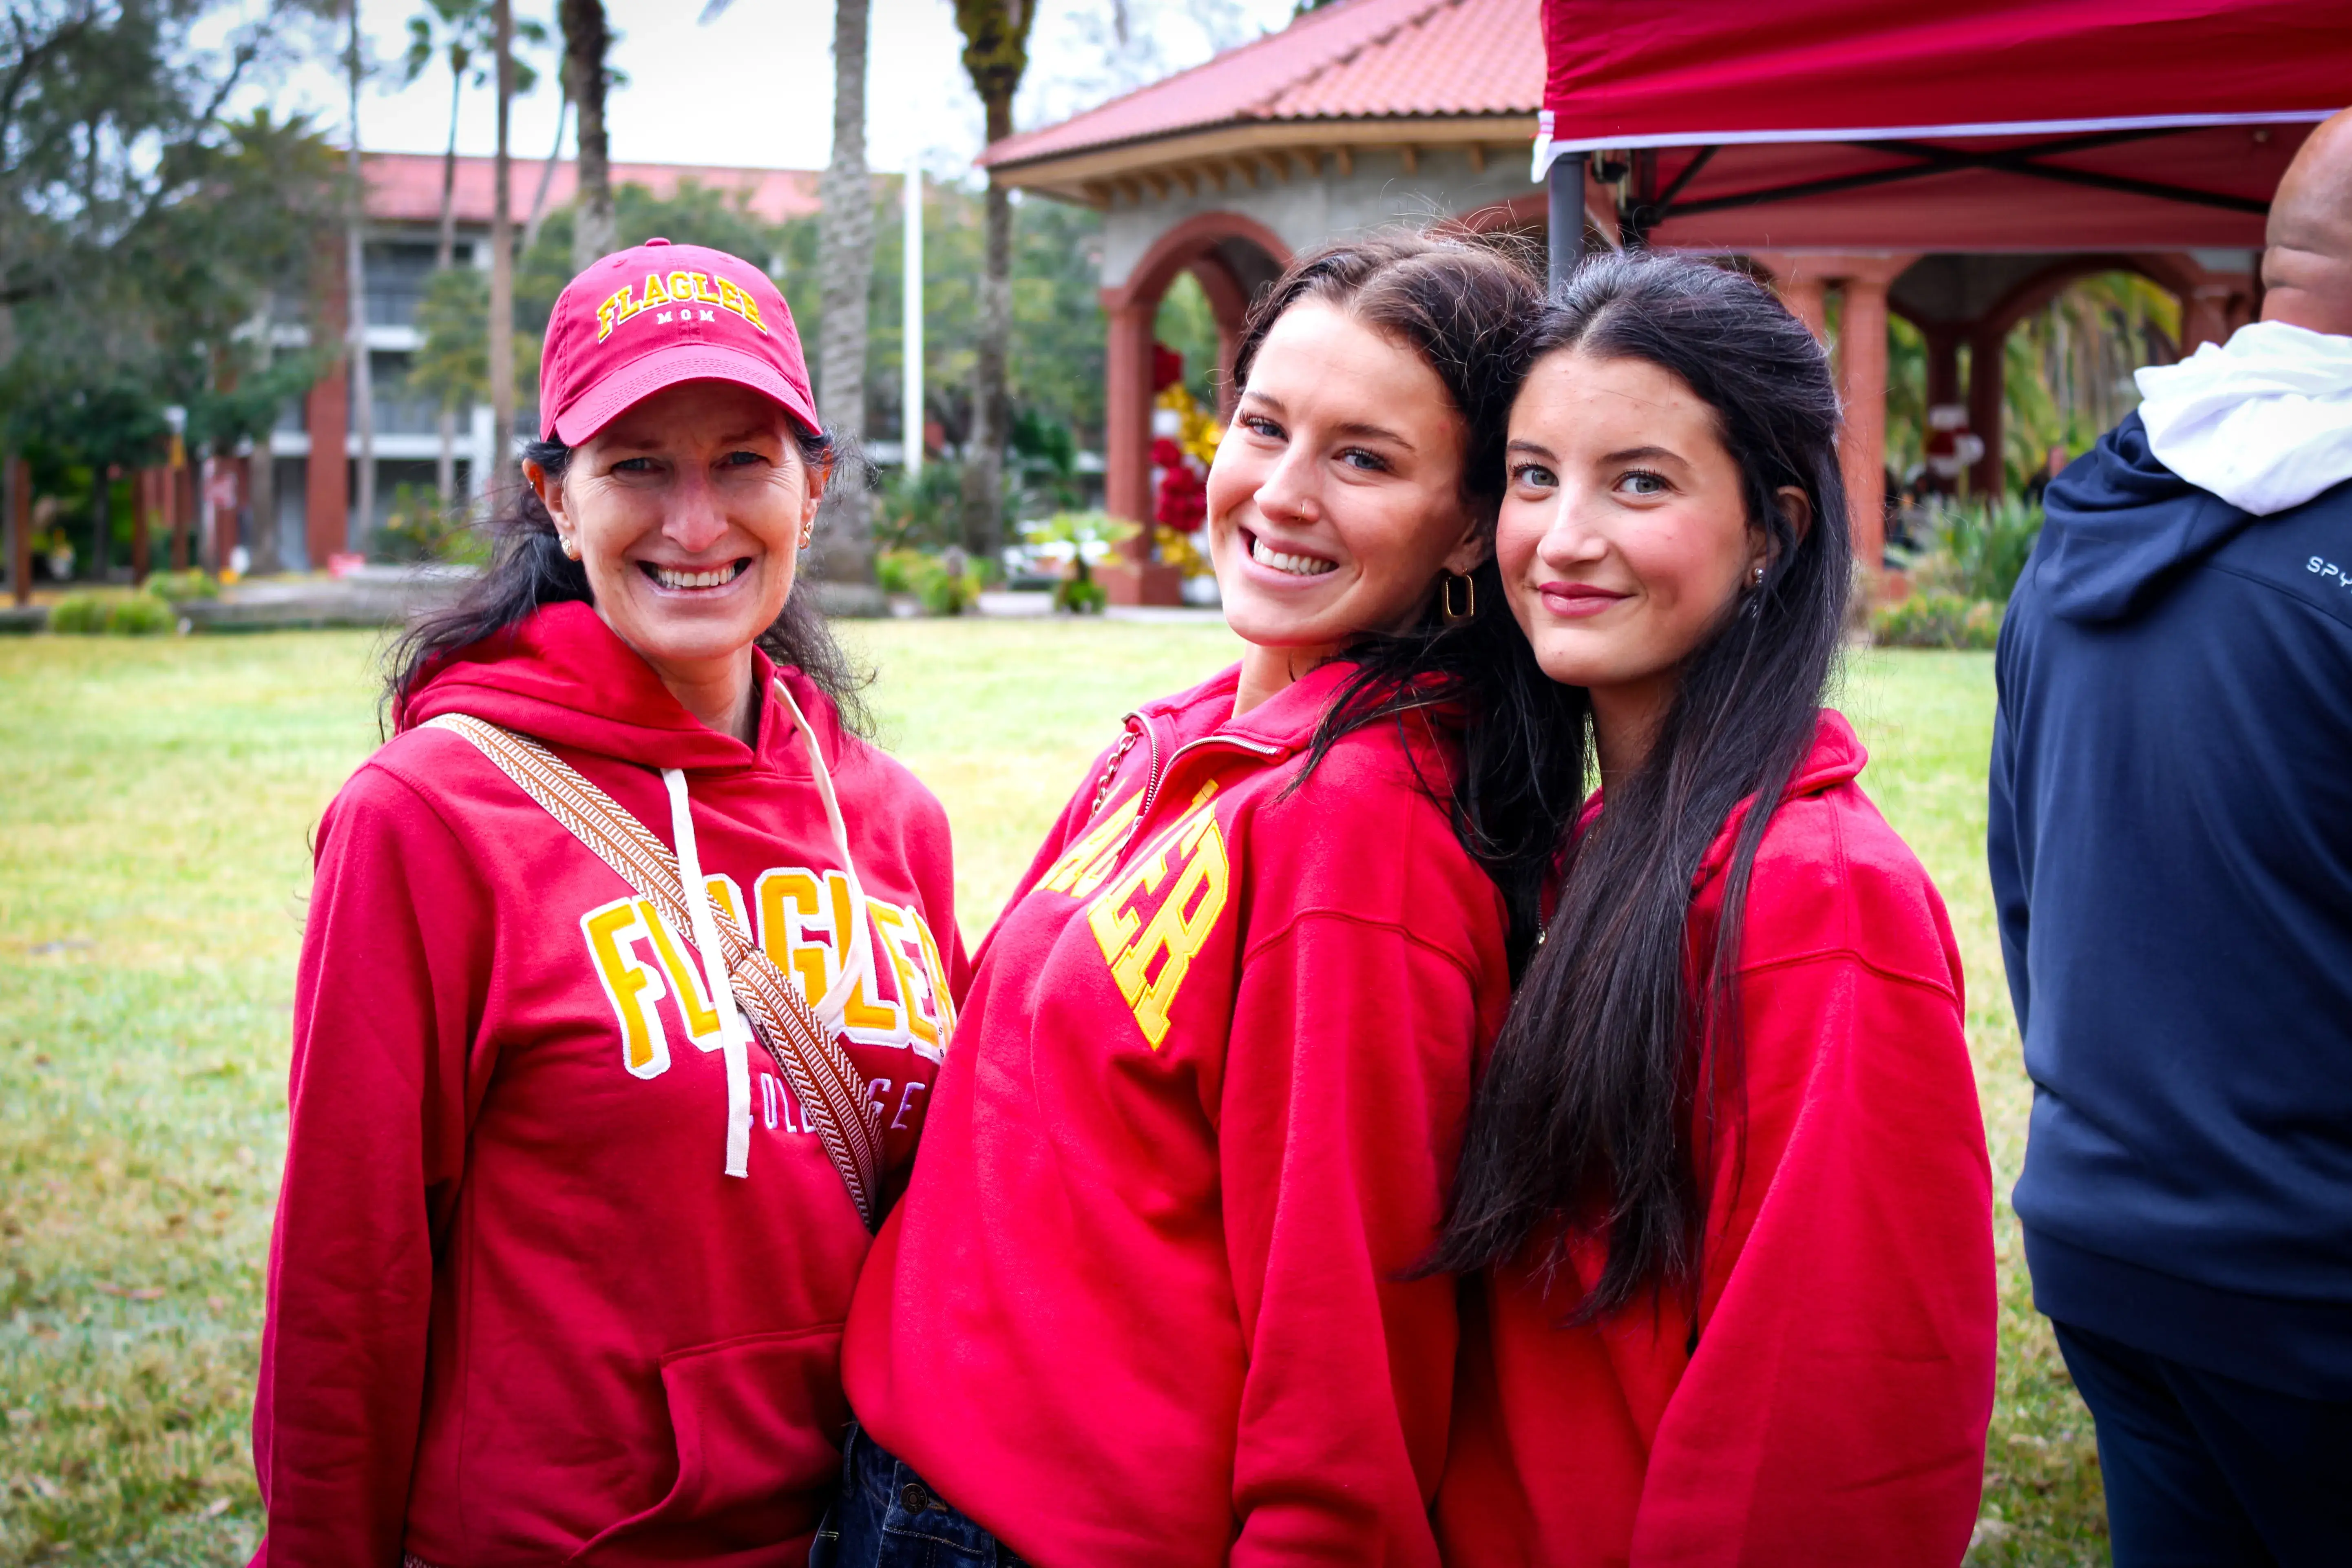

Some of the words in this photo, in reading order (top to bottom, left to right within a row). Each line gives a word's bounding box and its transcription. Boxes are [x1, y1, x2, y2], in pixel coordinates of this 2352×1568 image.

[597, 271, 767, 344] FLAGLER
[657, 309, 715, 325] MOM
[2306, 555, 2352, 593] SPY
